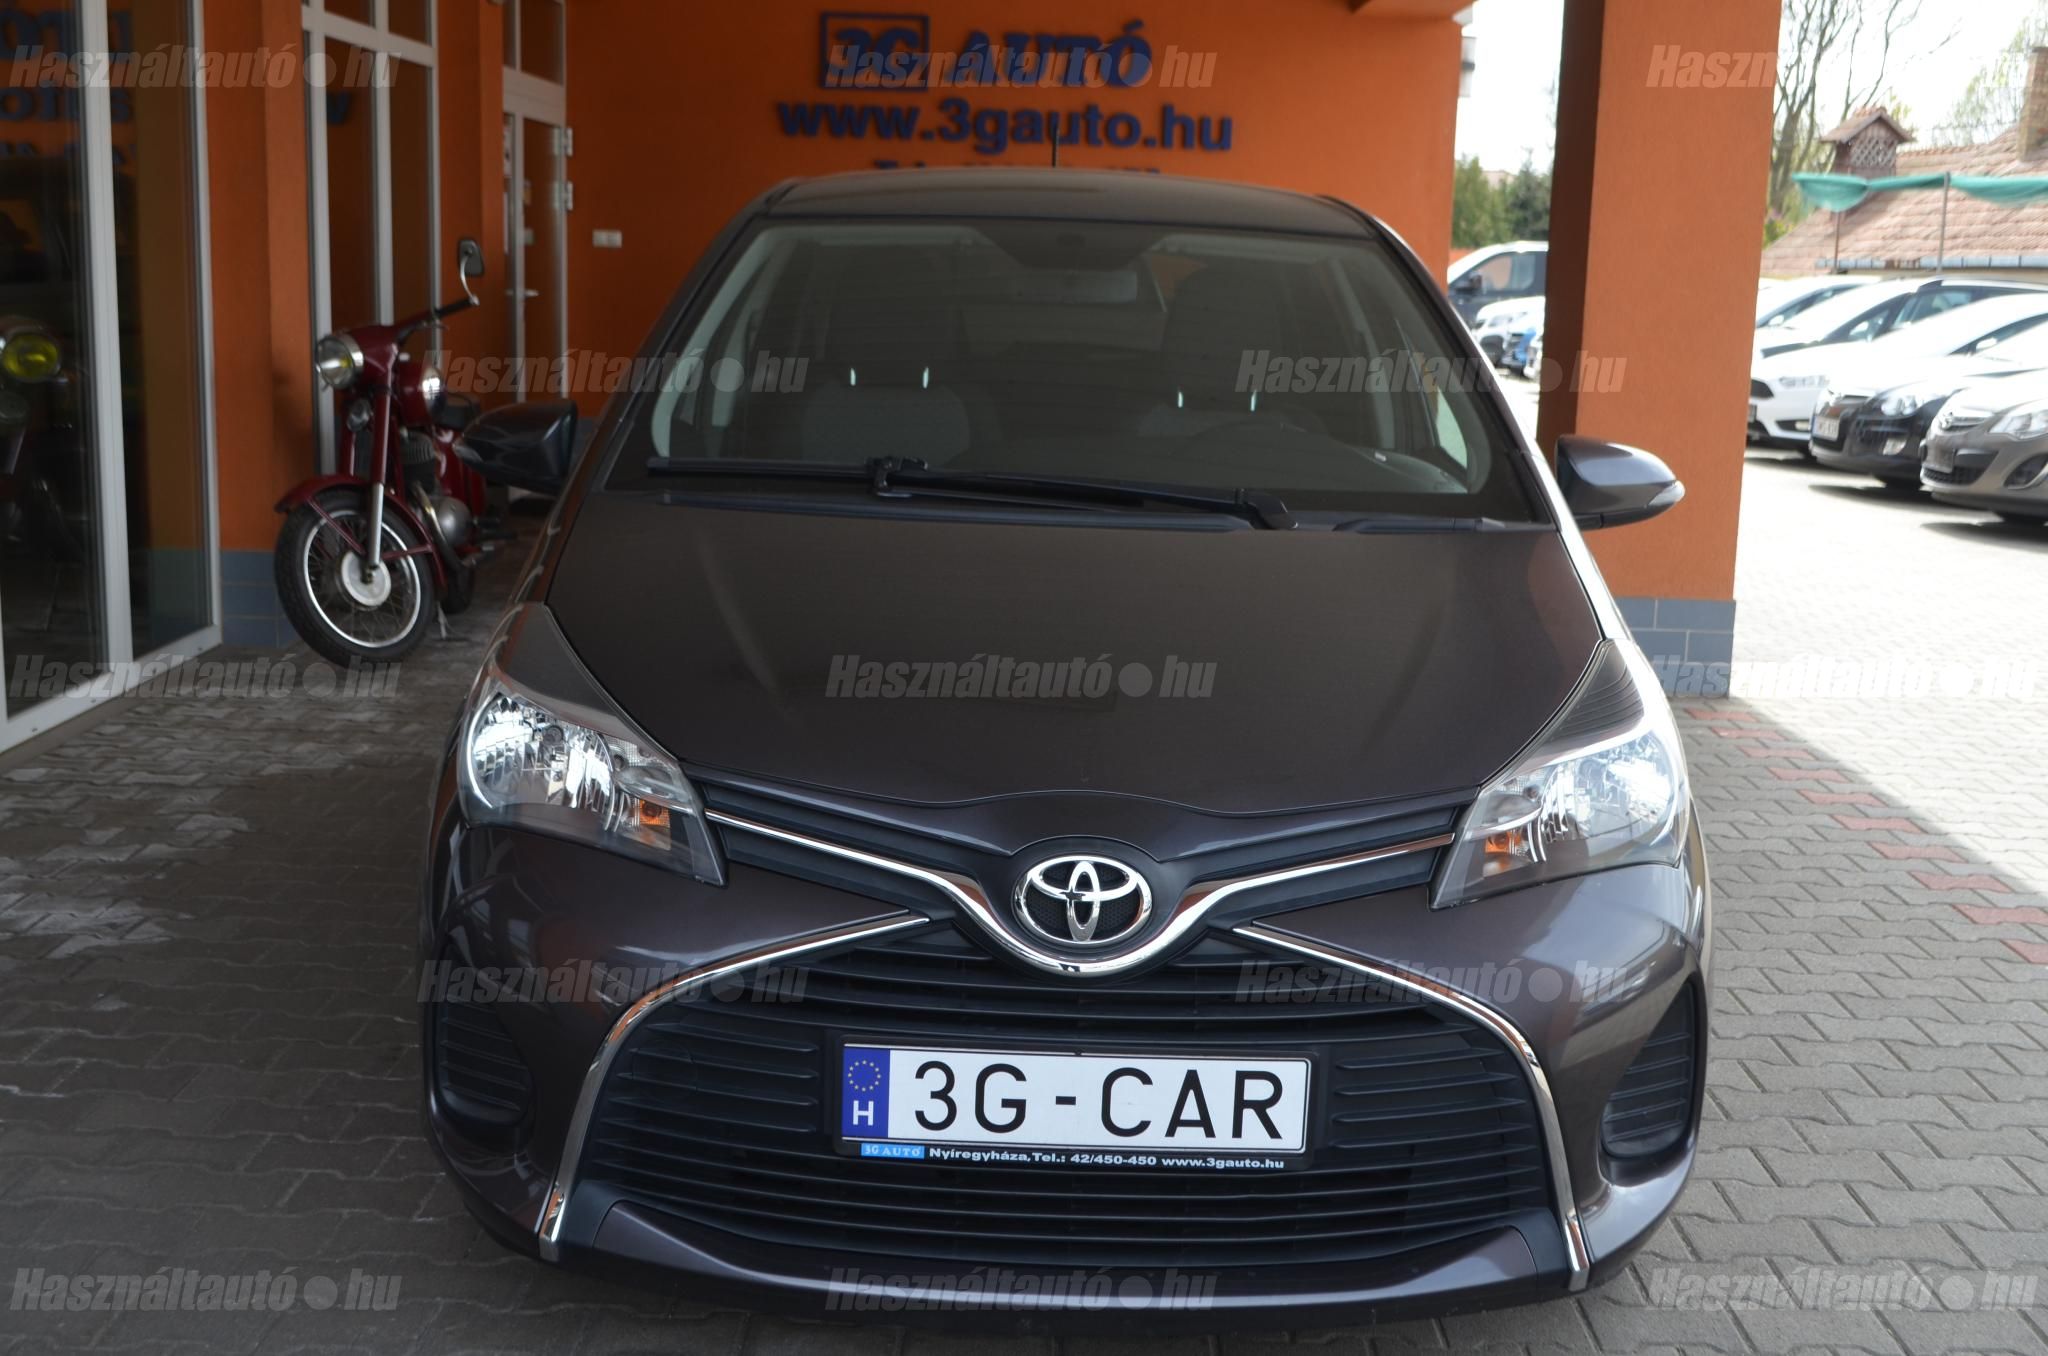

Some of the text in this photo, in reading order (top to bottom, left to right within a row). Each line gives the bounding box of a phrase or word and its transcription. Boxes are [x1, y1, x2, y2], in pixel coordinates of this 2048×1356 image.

[777, 98, 1232, 154] www.3gauto.hu
[852, 1100, 874, 1126] H
[1070, 1154, 1157, 1166] 42/450-450
[1162, 1157, 1285, 1169] www.3gauto.hu
